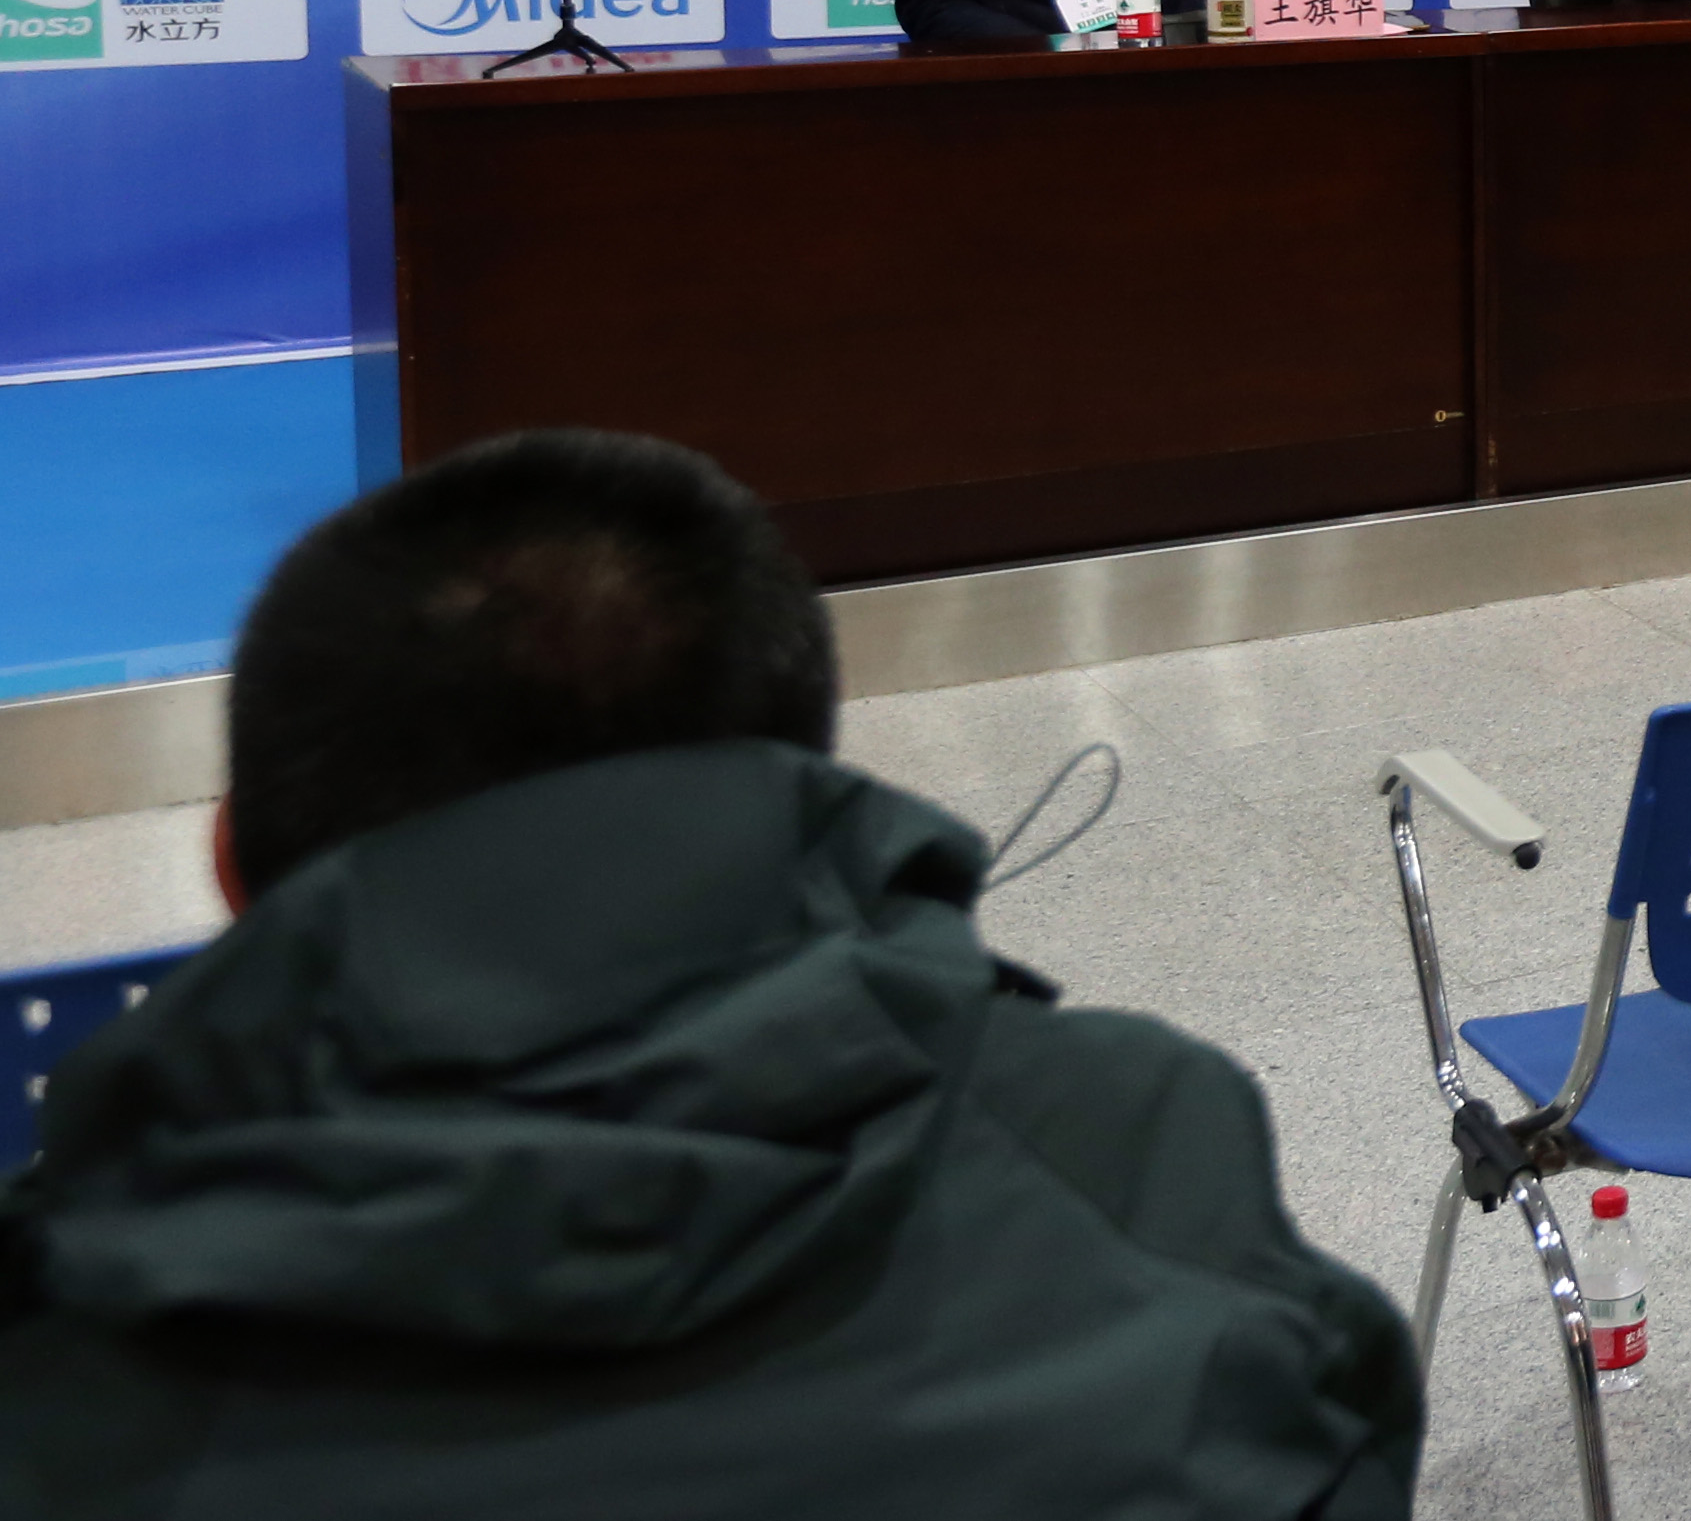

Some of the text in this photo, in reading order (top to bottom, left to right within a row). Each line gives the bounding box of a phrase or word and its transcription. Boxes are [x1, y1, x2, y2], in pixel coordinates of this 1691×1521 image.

[122, 5, 223, 16] WATER CUBE
[0, 13, 94, 39] hosa
[126, 18, 221, 42] 水立方
